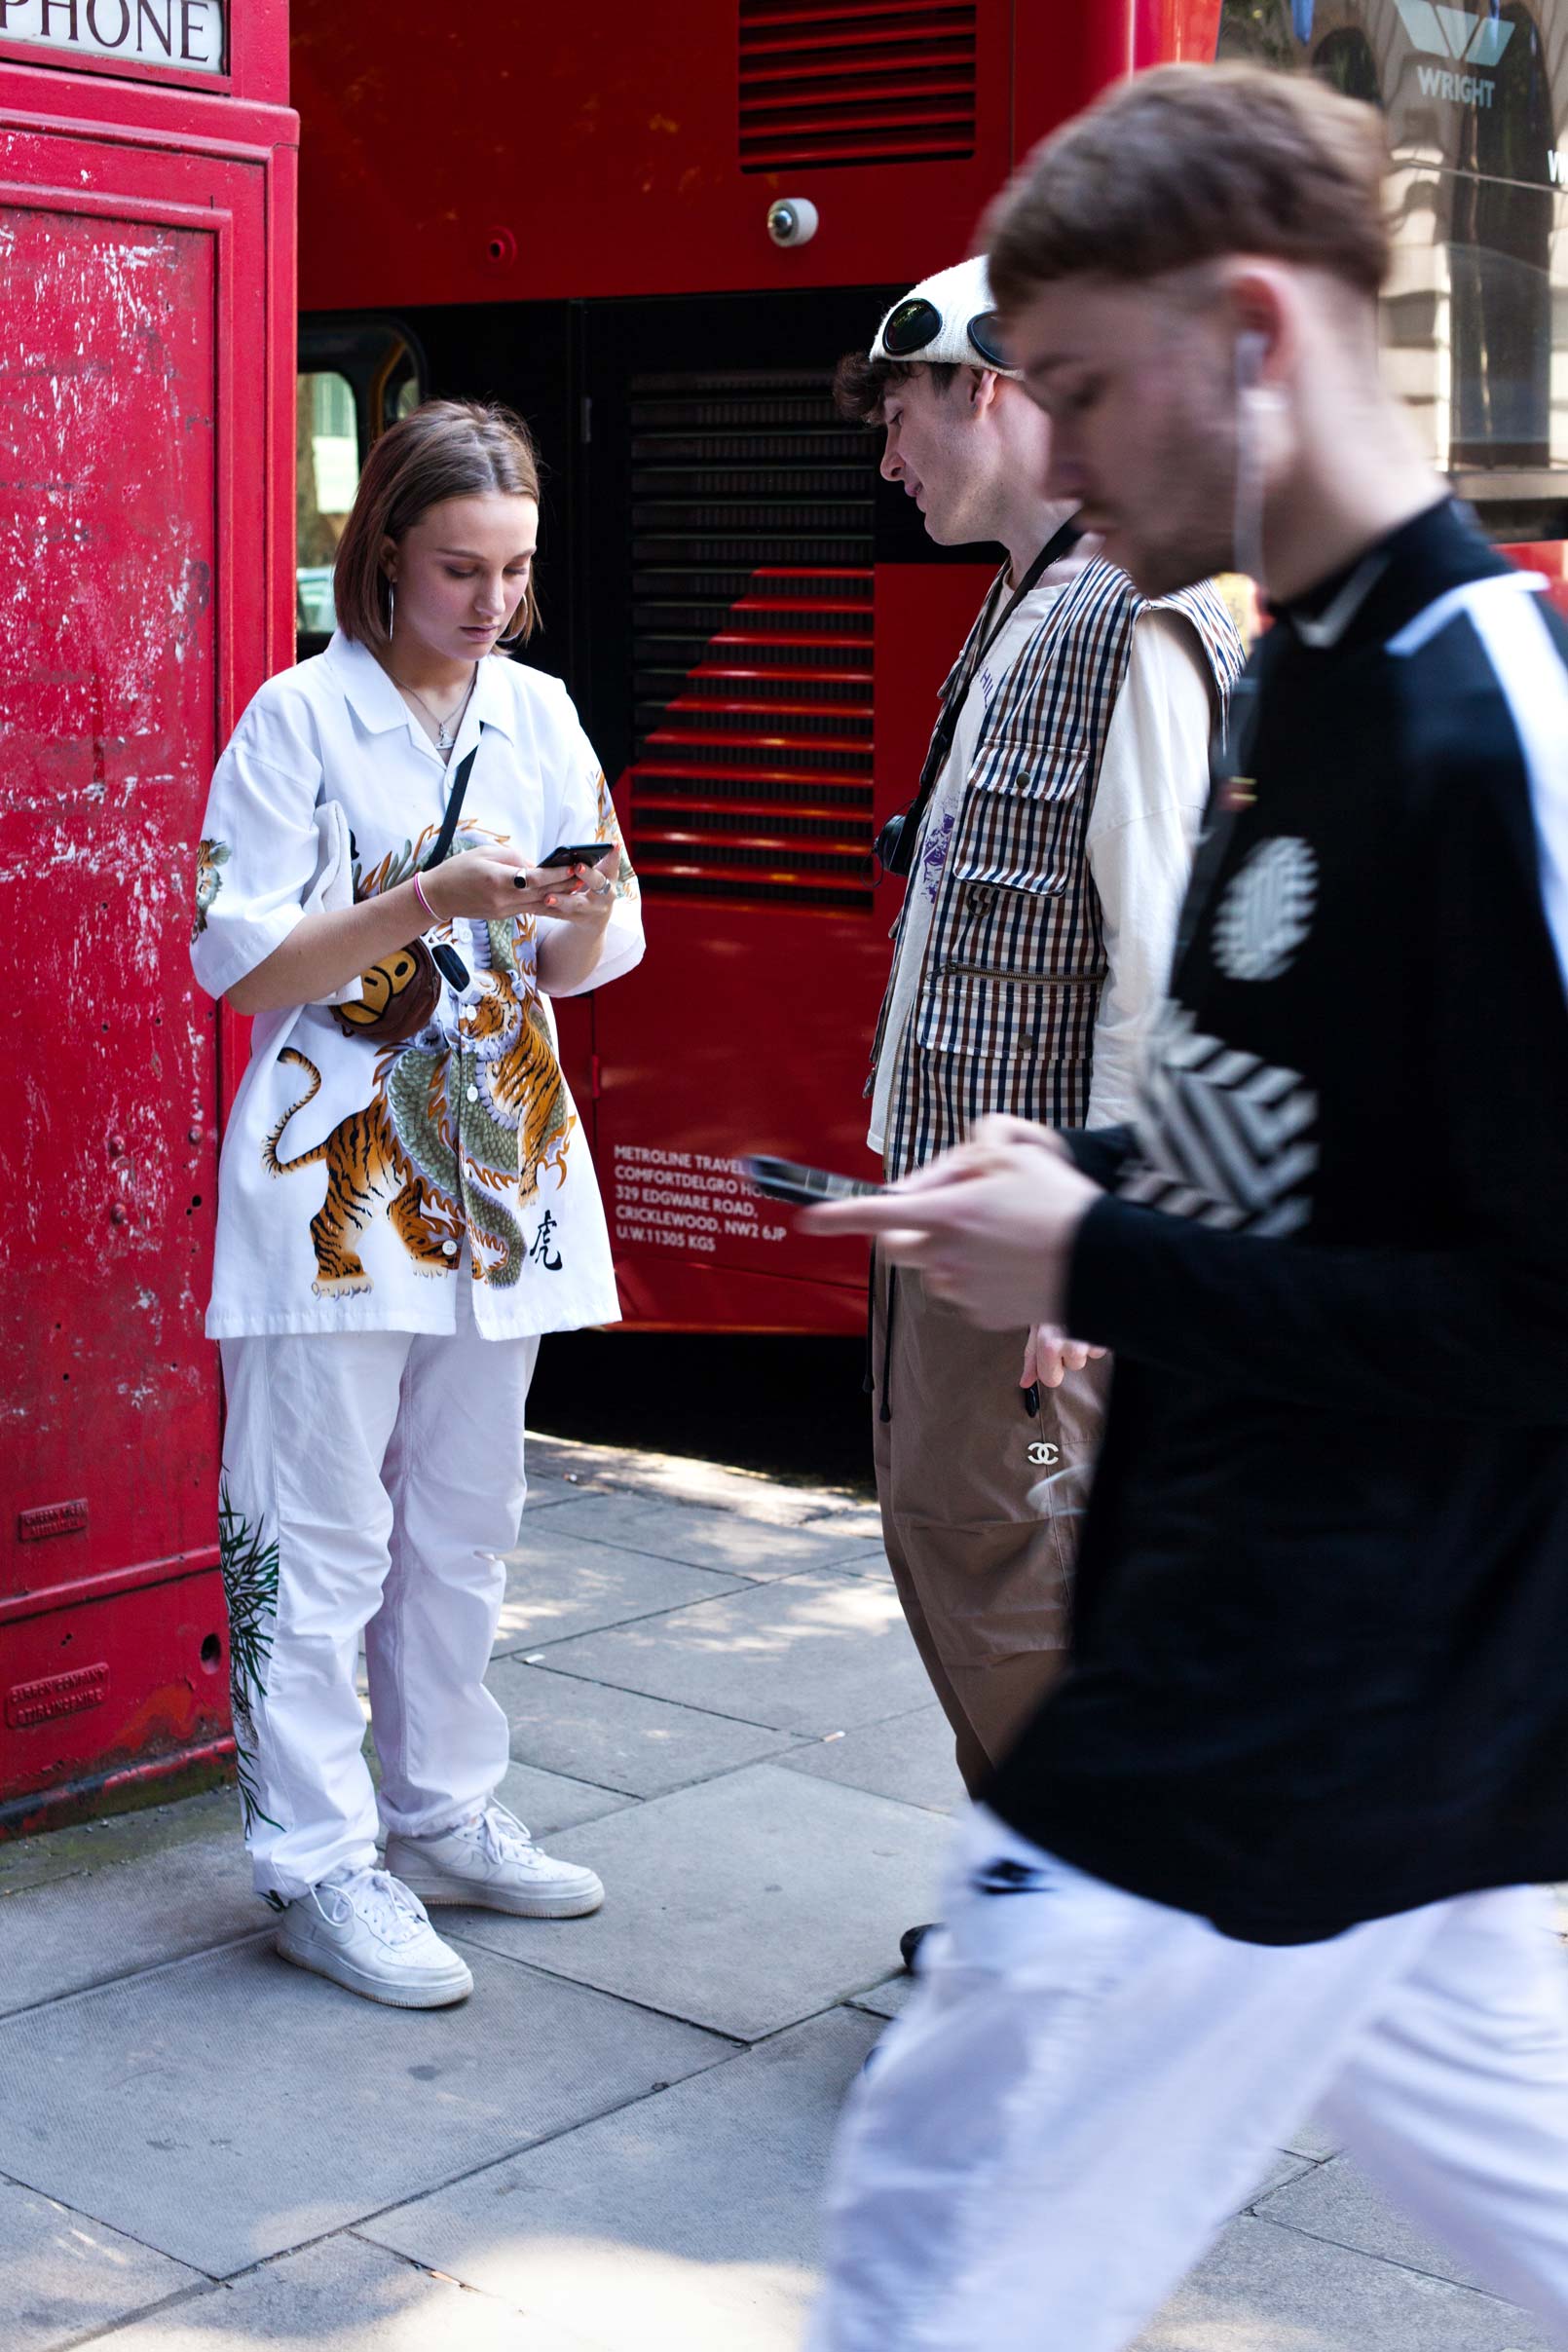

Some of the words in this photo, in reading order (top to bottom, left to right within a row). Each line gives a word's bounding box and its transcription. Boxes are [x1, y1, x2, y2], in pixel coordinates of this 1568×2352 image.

[1417, 64, 1496, 108] WRIGHT
[614, 1144, 691, 1169] METROLINE
[694, 1154, 746, 1176] TRAVEL
[615, 1165, 738, 1194] COMFORTDELGRO
[616, 1184, 640, 1201] 329
[643, 1188, 710, 1211] EDGWARE
[713, 1198, 759, 1218] ROAD,
[529, 1209, 563, 1271] 虎
[616, 1205, 723, 1233] CRICKLEWOOD,
[725, 1220, 759, 1238] NW2
[762, 1226, 787, 1243] 6JP
[688, 1235, 717, 1252] KGS
